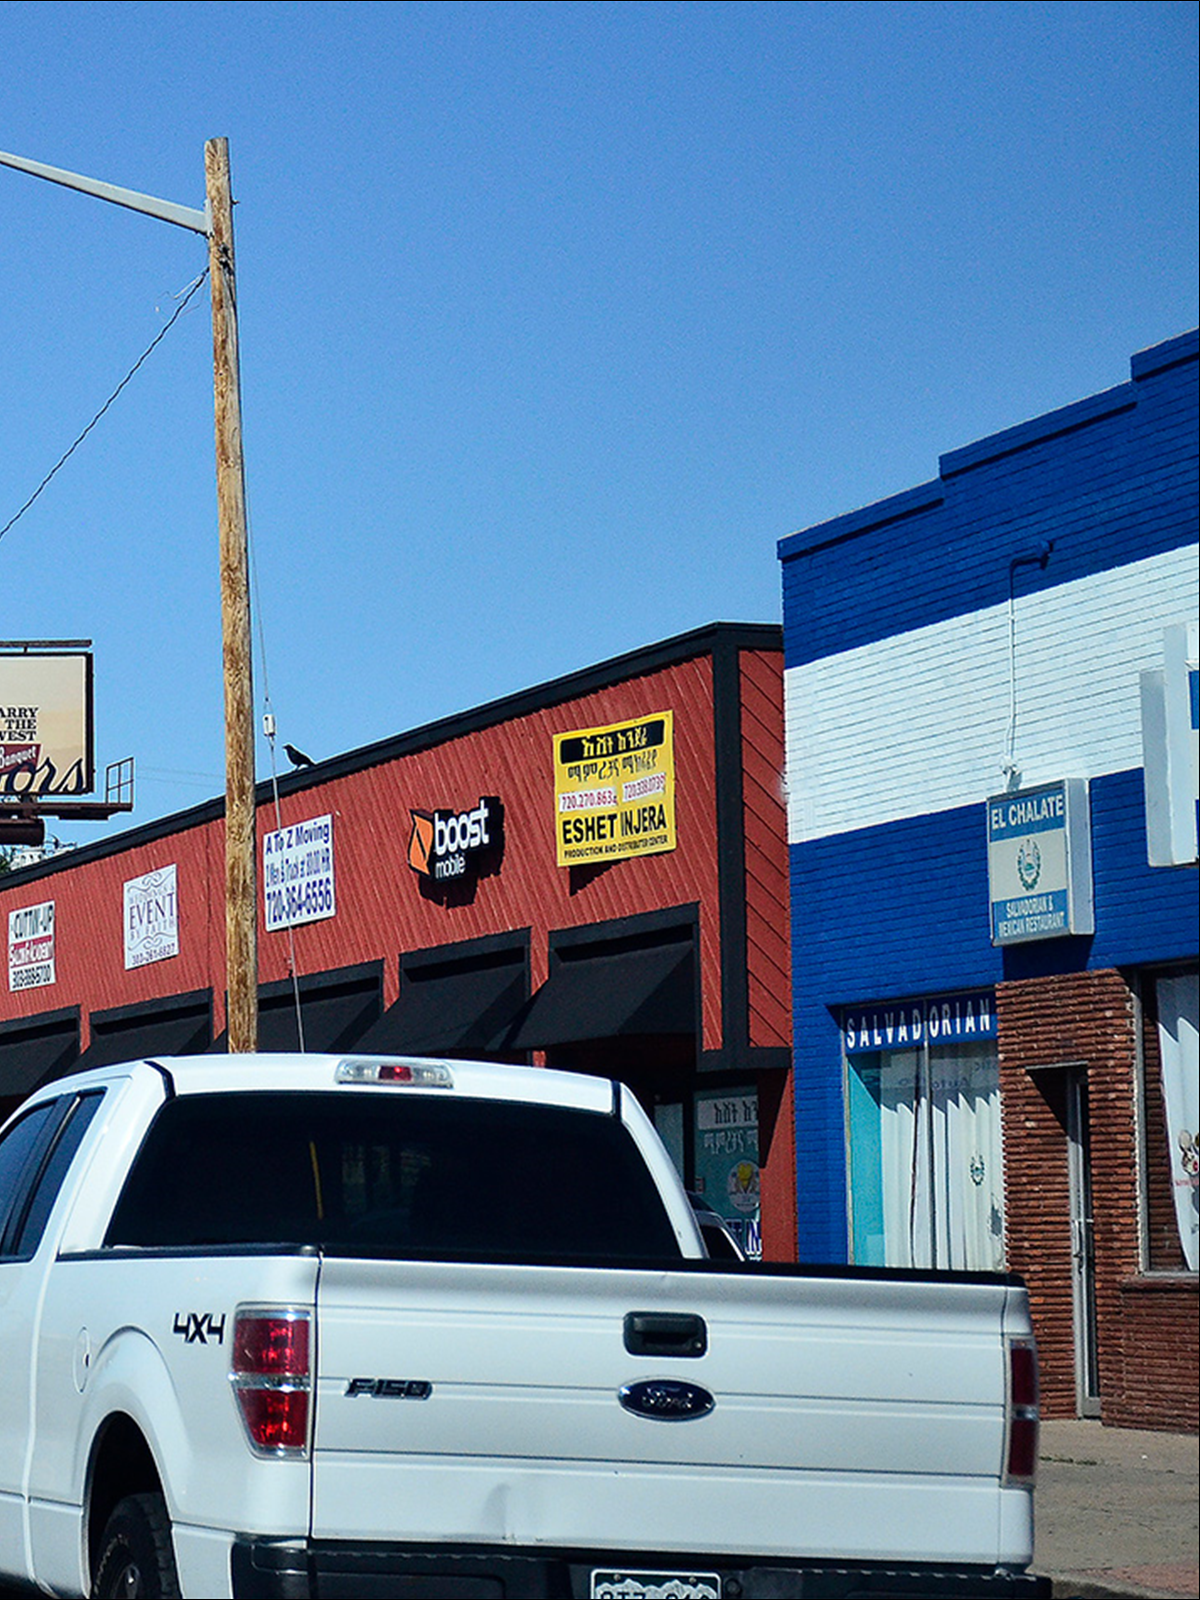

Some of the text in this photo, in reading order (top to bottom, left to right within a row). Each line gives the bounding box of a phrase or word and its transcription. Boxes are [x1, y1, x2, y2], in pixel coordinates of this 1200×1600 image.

[4, 718, 37, 730] THE
[434, 799, 490, 856] boost
[562, 803, 667, 845] ESHET INJERA
[991, 794, 1064, 830] EL CHALATE
[266, 822, 330, 856] A To Z Moving
[564, 845, 603, 859] PRODUCTION
[604, 843, 617, 854] AND
[435, 854, 466, 879] mobile
[129, 891, 175, 930] EVENT
[999, 910, 1065, 938] MEXICAN RESTAURANT
[1006, 896, 1048, 919] SALVADORIAN
[846, 998, 991, 1050] SALVADORIAN
[173, 1313, 226, 1345] 4X4
